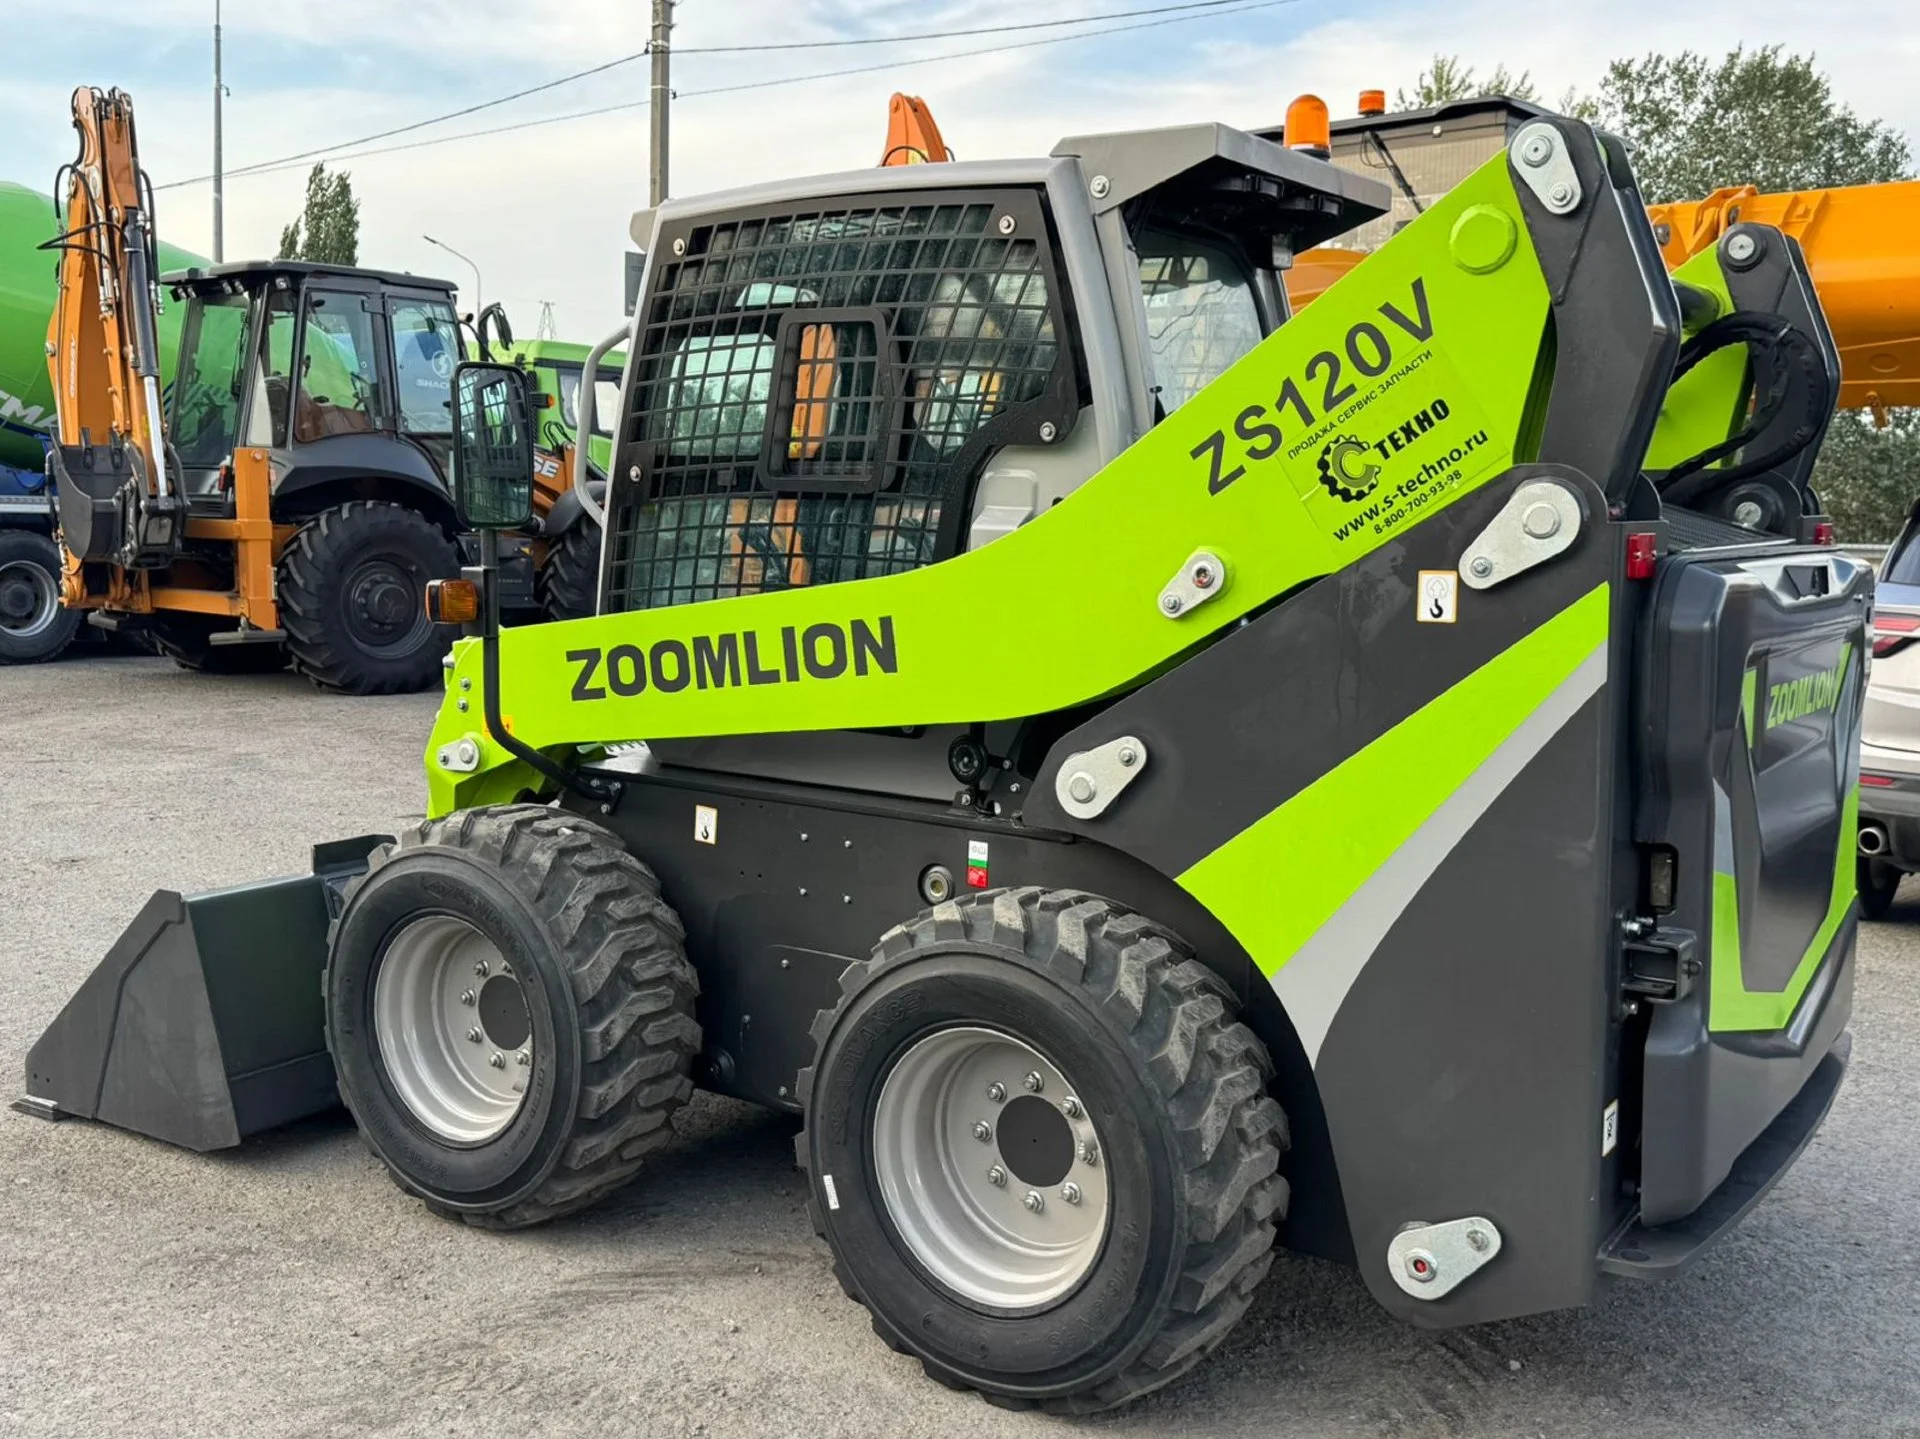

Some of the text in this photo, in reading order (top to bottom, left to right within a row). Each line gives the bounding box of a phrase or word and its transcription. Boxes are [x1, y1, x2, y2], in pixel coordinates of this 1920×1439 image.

[1189, 276, 1434, 497] ZS120V
[1287, 350, 1434, 460] ПРОДАЖА СЕРВИС ЗАПЧАСТИ
[1333, 429, 1489, 542] www.s-techno.ru
[1373, 469, 1463, 535] 8-800-700-93-98
[566, 615, 898, 701] ZOOMLION
[1766, 667, 1838, 730] ZOOMLION
